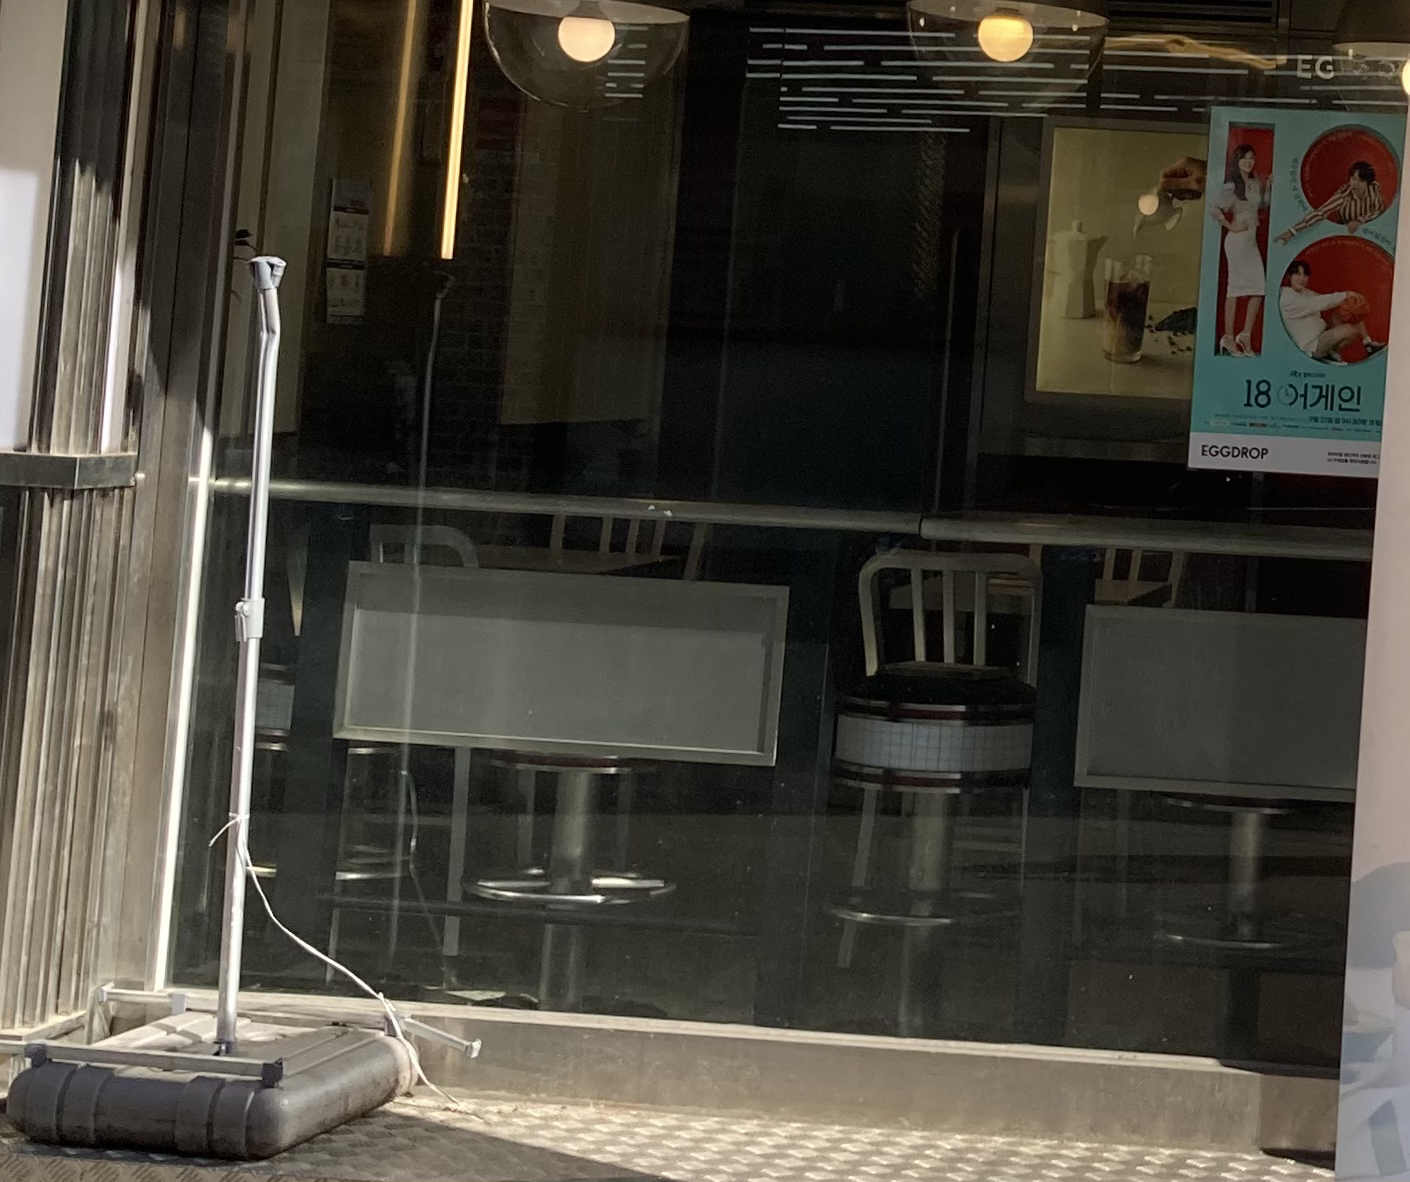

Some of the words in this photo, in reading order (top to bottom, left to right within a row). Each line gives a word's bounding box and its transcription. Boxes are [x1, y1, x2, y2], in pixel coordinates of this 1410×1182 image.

[1243, 378, 1272, 409] 18
[1276, 382, 1362, 413] 어게인
[1201, 444, 1269, 460] EGGDROP
